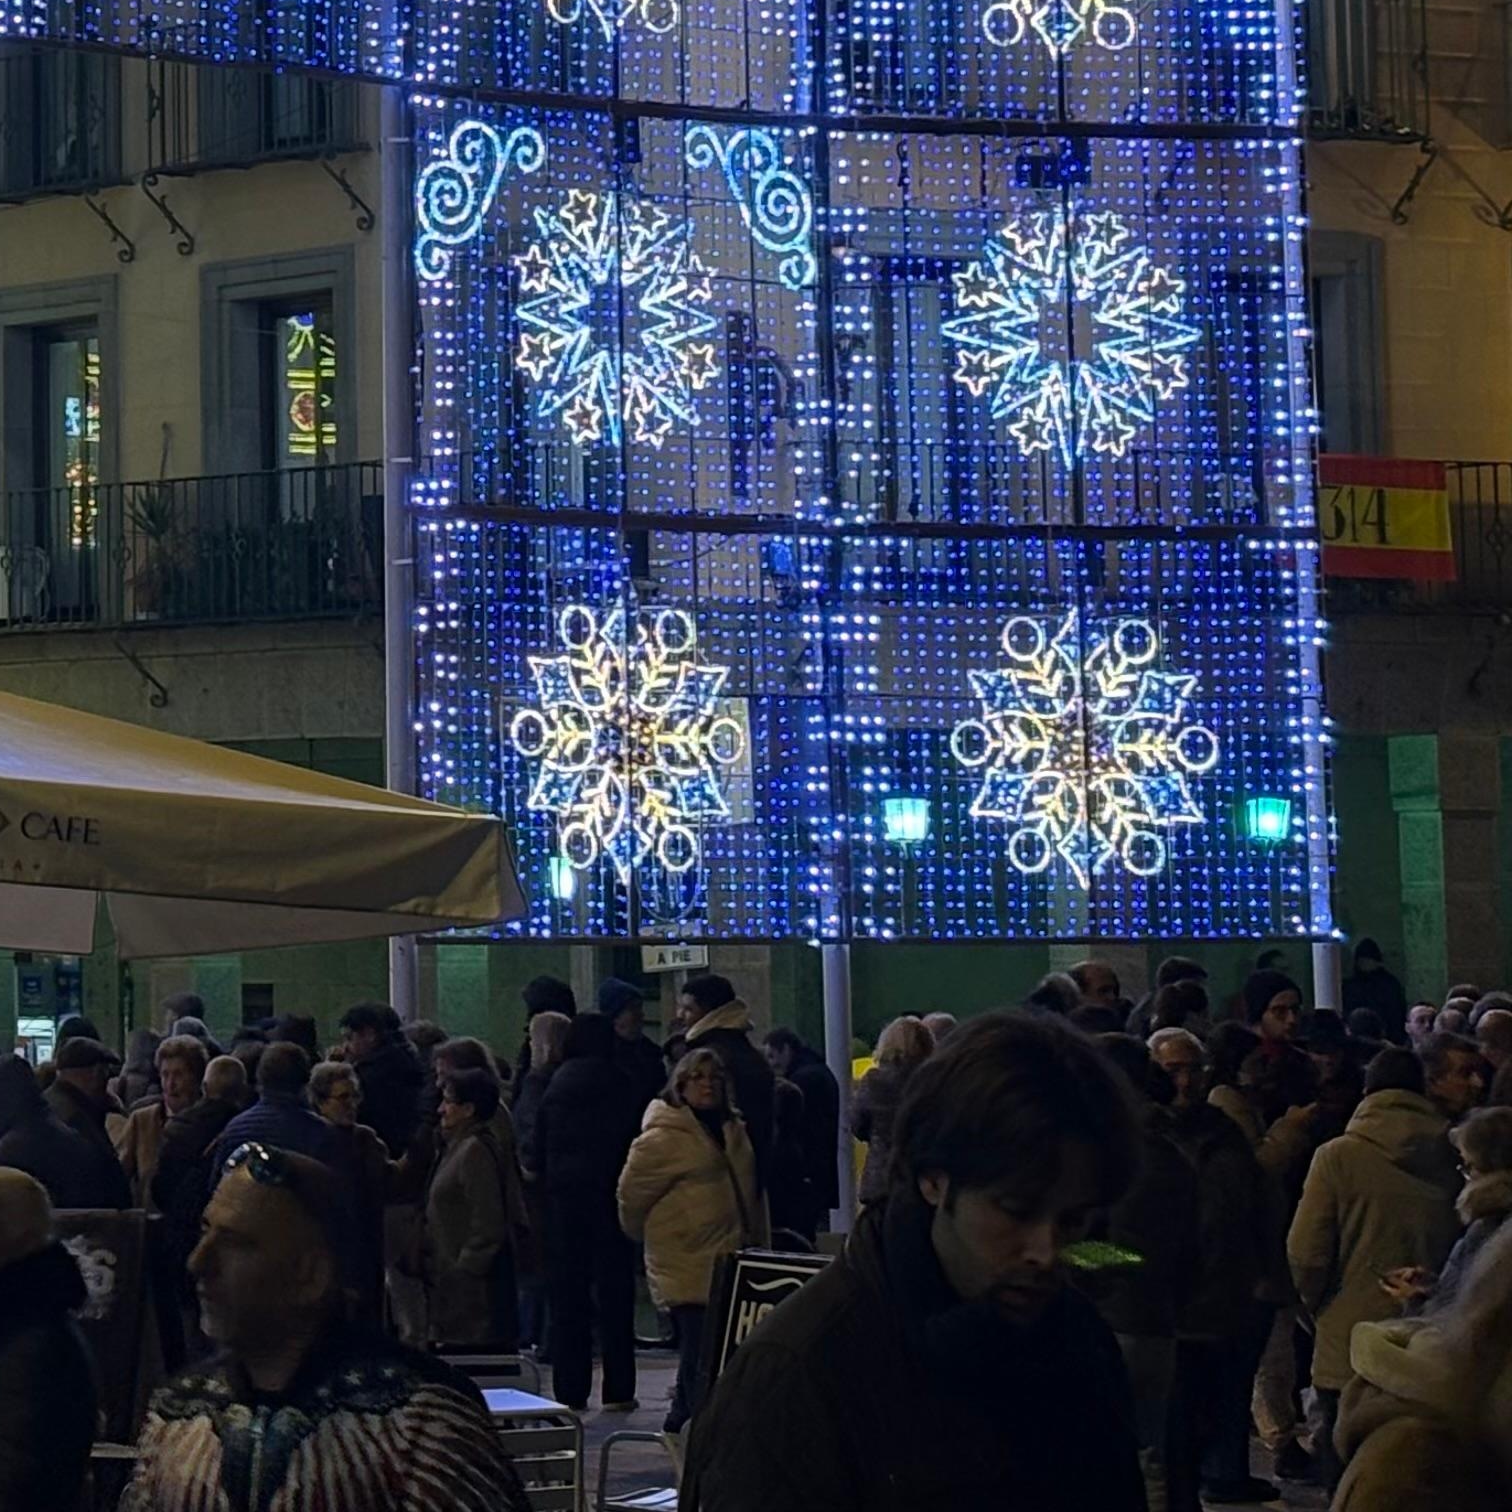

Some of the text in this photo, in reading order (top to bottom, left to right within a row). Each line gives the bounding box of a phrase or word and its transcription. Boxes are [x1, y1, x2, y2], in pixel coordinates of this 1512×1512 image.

[20, 811, 101, 846] CAFE
[657, 949, 691, 965] A PIE
